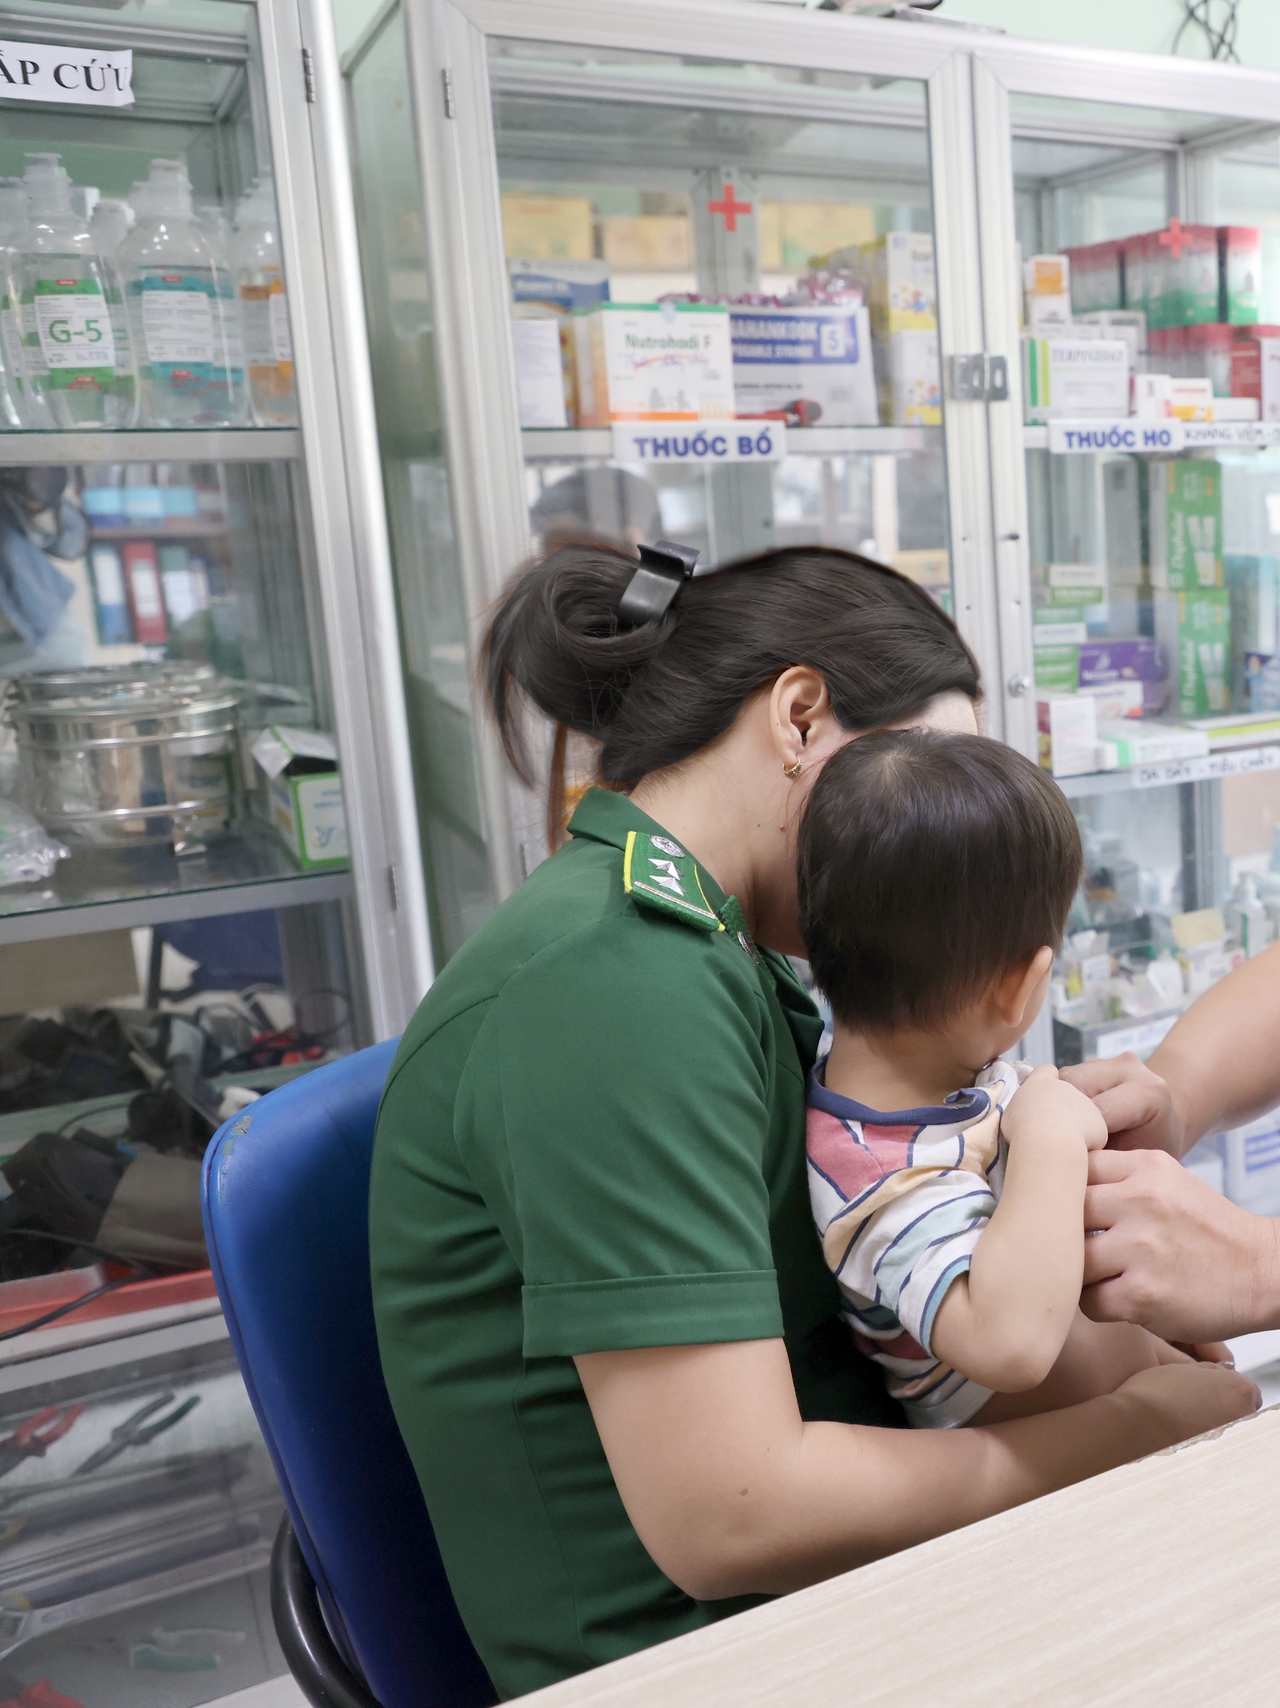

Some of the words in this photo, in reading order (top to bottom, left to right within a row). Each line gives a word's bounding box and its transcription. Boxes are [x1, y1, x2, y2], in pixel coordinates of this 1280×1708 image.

[53, 58, 128, 92] CỨU
[49, 319, 102, 343] G-5
[632, 428, 728, 458] THUỐC
[1064, 422, 1135, 448] THUỐC
[1143, 430, 1172, 447] HO
